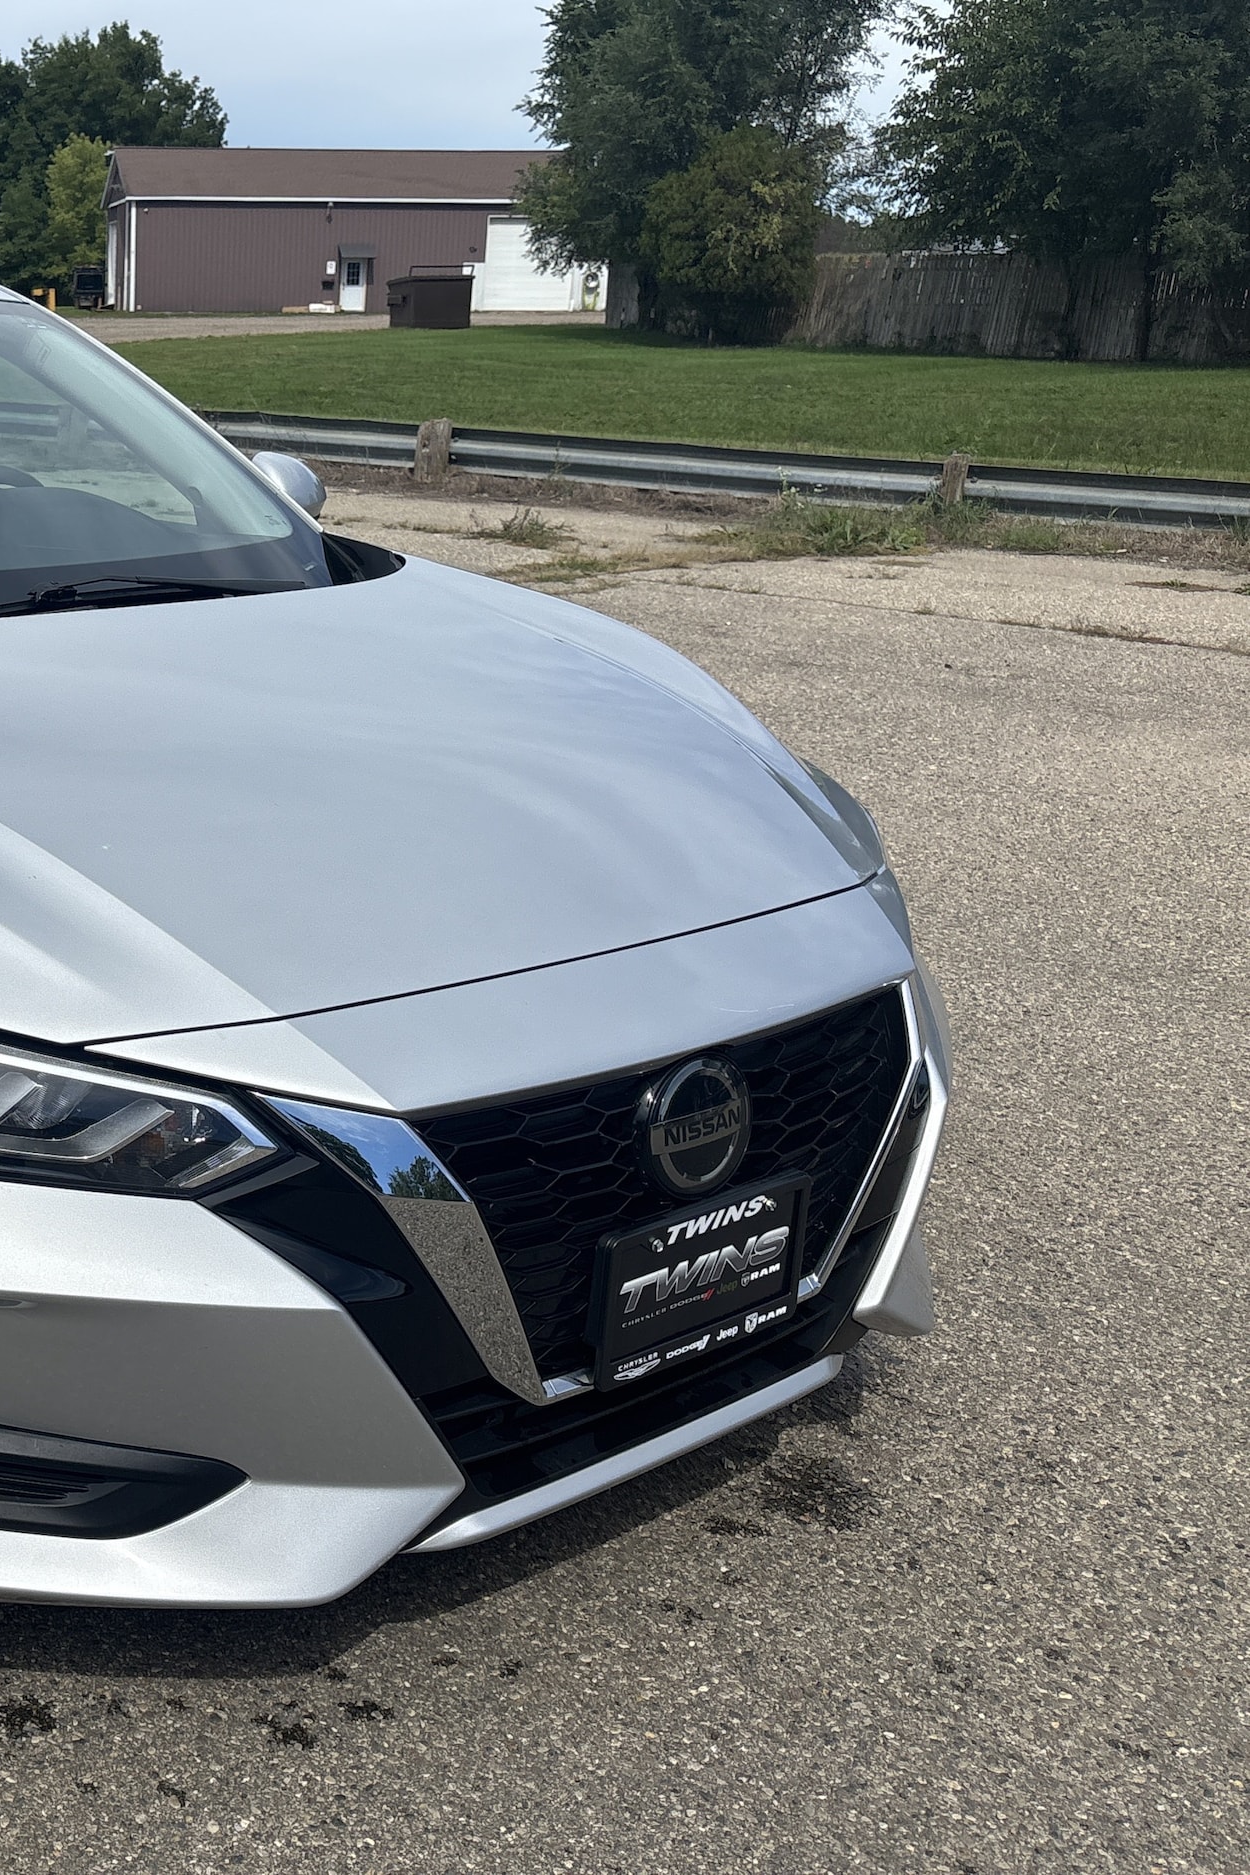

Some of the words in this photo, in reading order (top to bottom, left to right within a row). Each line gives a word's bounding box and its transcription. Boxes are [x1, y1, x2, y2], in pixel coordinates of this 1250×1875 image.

[664, 1105, 740, 1147] NISSAN
[667, 1195, 767, 1246] TWINS
[619, 1226, 790, 1314] TWINS
[621, 1307, 667, 1329] CHRYSLER
[716, 1280, 738, 1295] Jeep
[750, 1262, 781, 1281] RAM
[617, 1352, 659, 1372] CHRYSLER
[716, 1325, 739, 1341] Jeep
[757, 1305, 788, 1325] RAM
